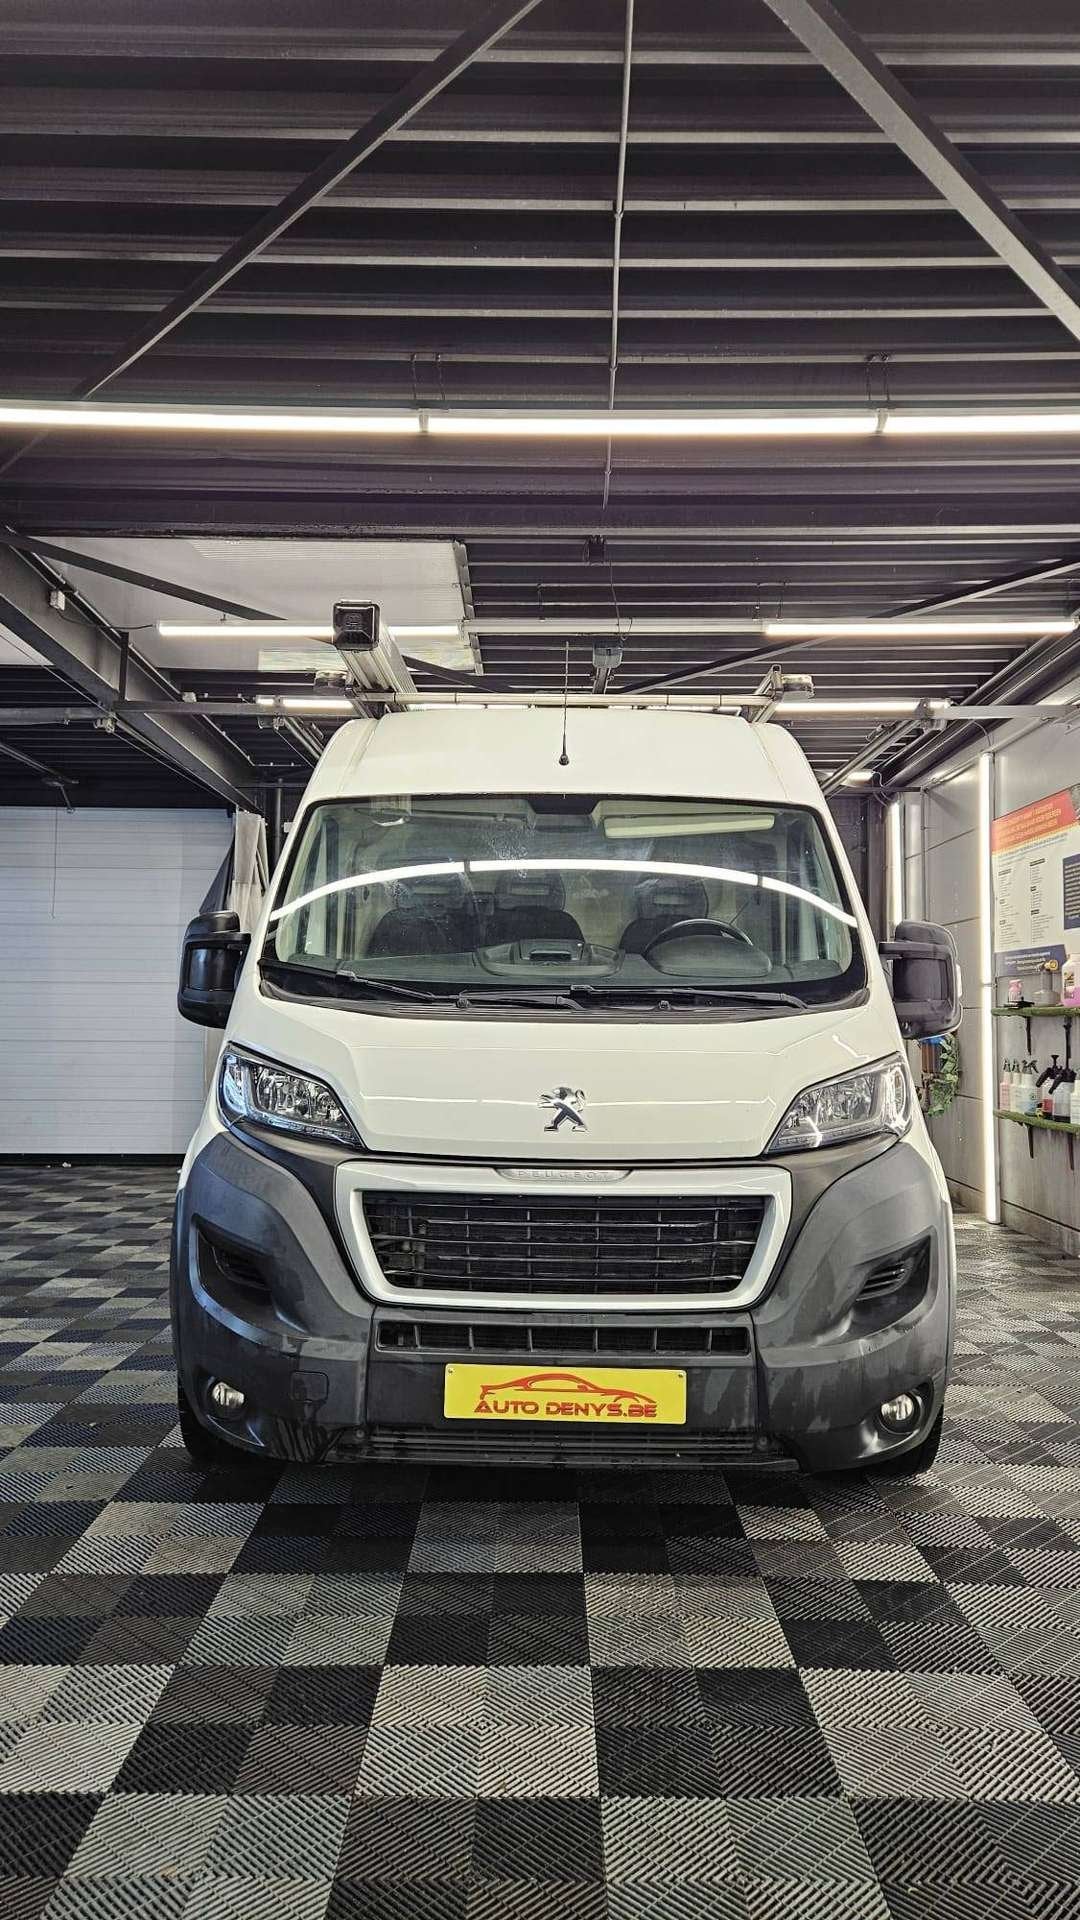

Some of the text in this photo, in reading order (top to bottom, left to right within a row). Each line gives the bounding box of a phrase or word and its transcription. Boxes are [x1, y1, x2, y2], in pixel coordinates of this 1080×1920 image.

[517, 1170, 609, 1179] PEUGEOT
[474, 1400, 658, 1418] AUTO DENYS.BE
